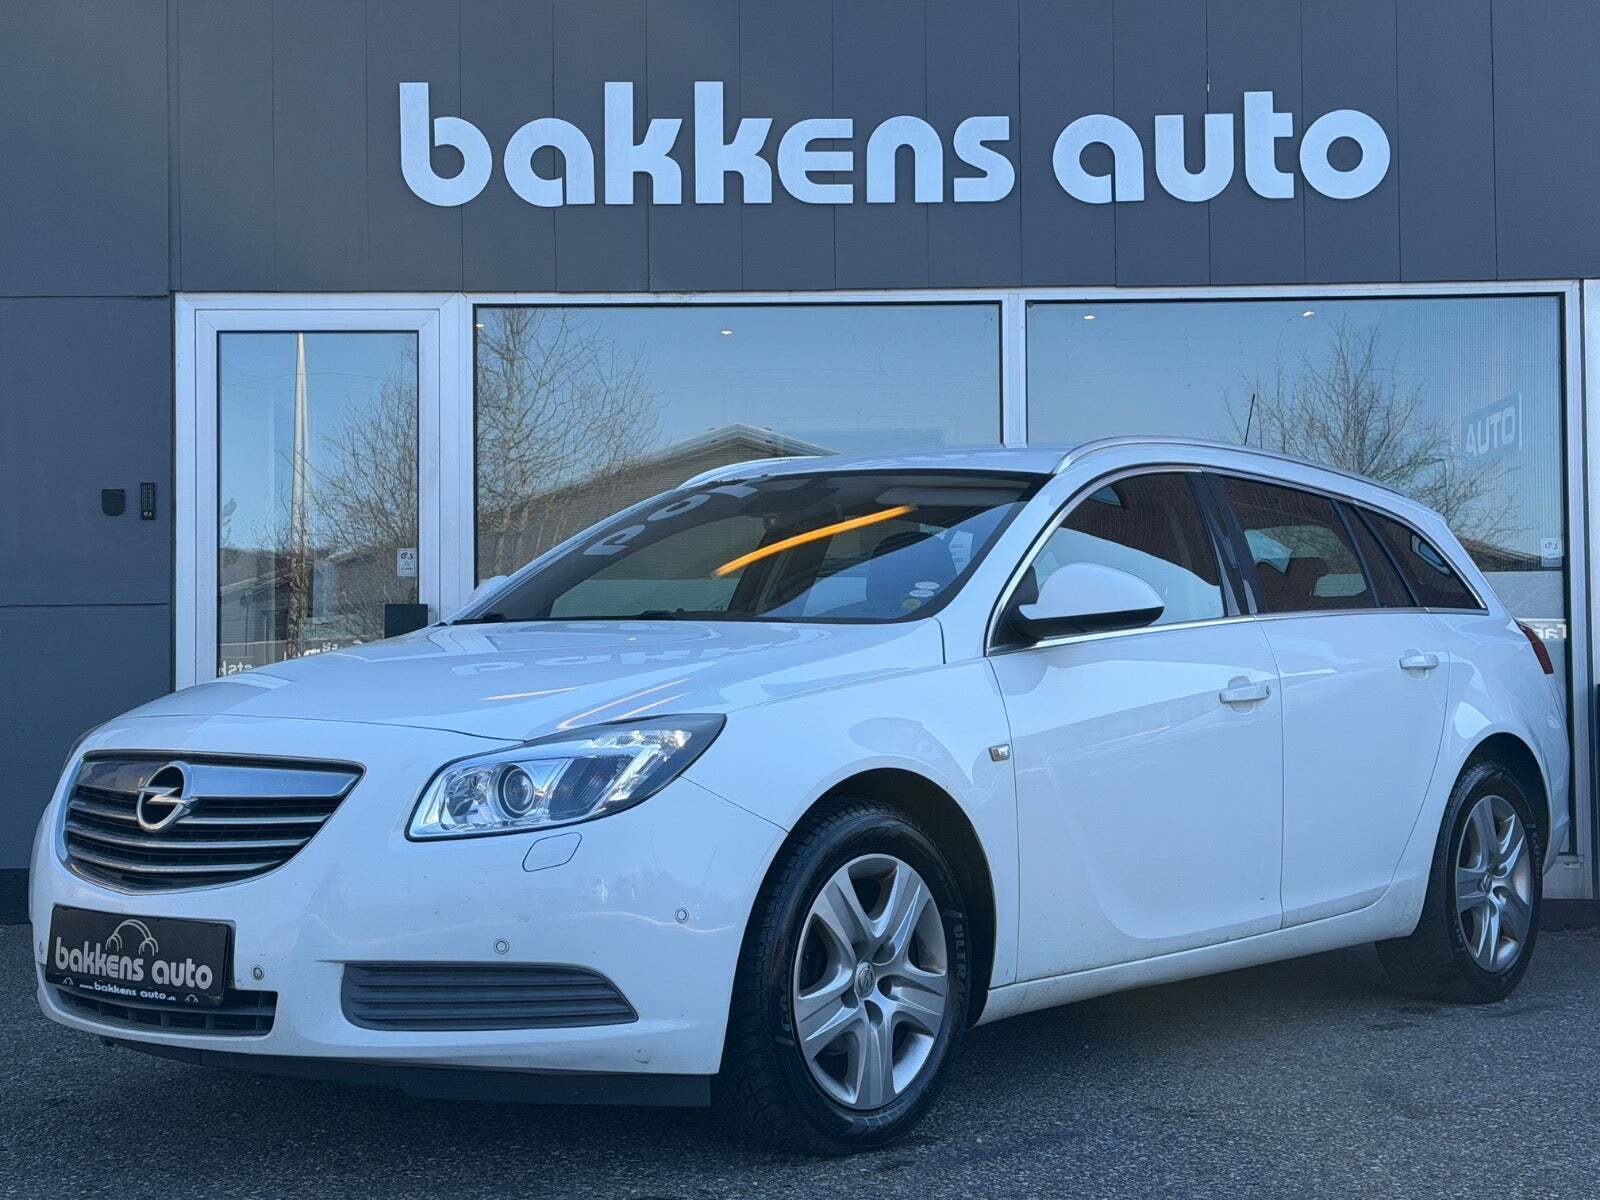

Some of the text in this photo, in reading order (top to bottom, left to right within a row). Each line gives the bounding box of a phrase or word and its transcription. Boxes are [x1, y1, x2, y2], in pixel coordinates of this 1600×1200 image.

[399, 80, 1391, 208] bakkens auto
[1466, 407, 1516, 457] AUTO
[55, 936, 214, 990] bakkens auto
